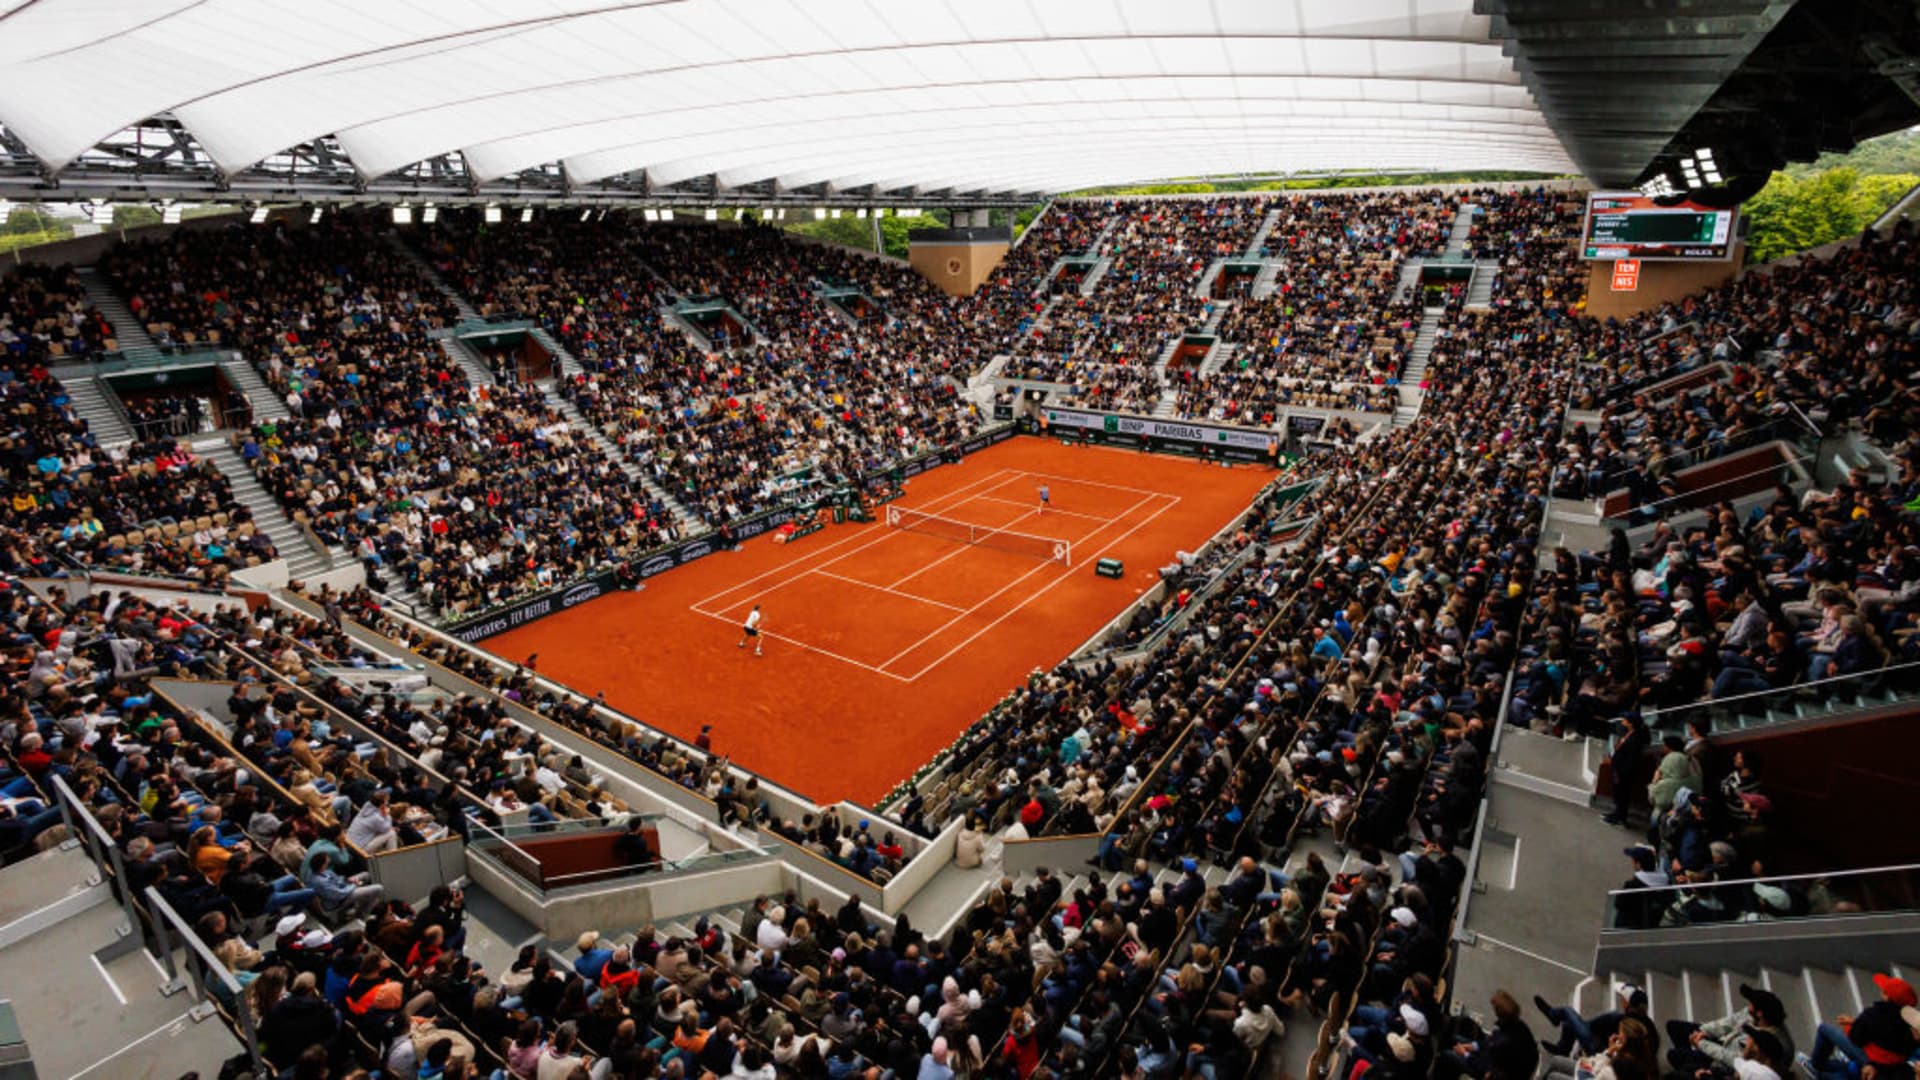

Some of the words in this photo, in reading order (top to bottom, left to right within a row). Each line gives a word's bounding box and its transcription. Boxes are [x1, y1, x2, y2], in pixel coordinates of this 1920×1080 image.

[1618, 264, 1635, 272] TEN
[1616, 277, 1633, 286] NIS
[1121, 421, 1144, 431] BNP
[1154, 424, 1202, 439] PARIBAS
[461, 618, 507, 642] mirates
